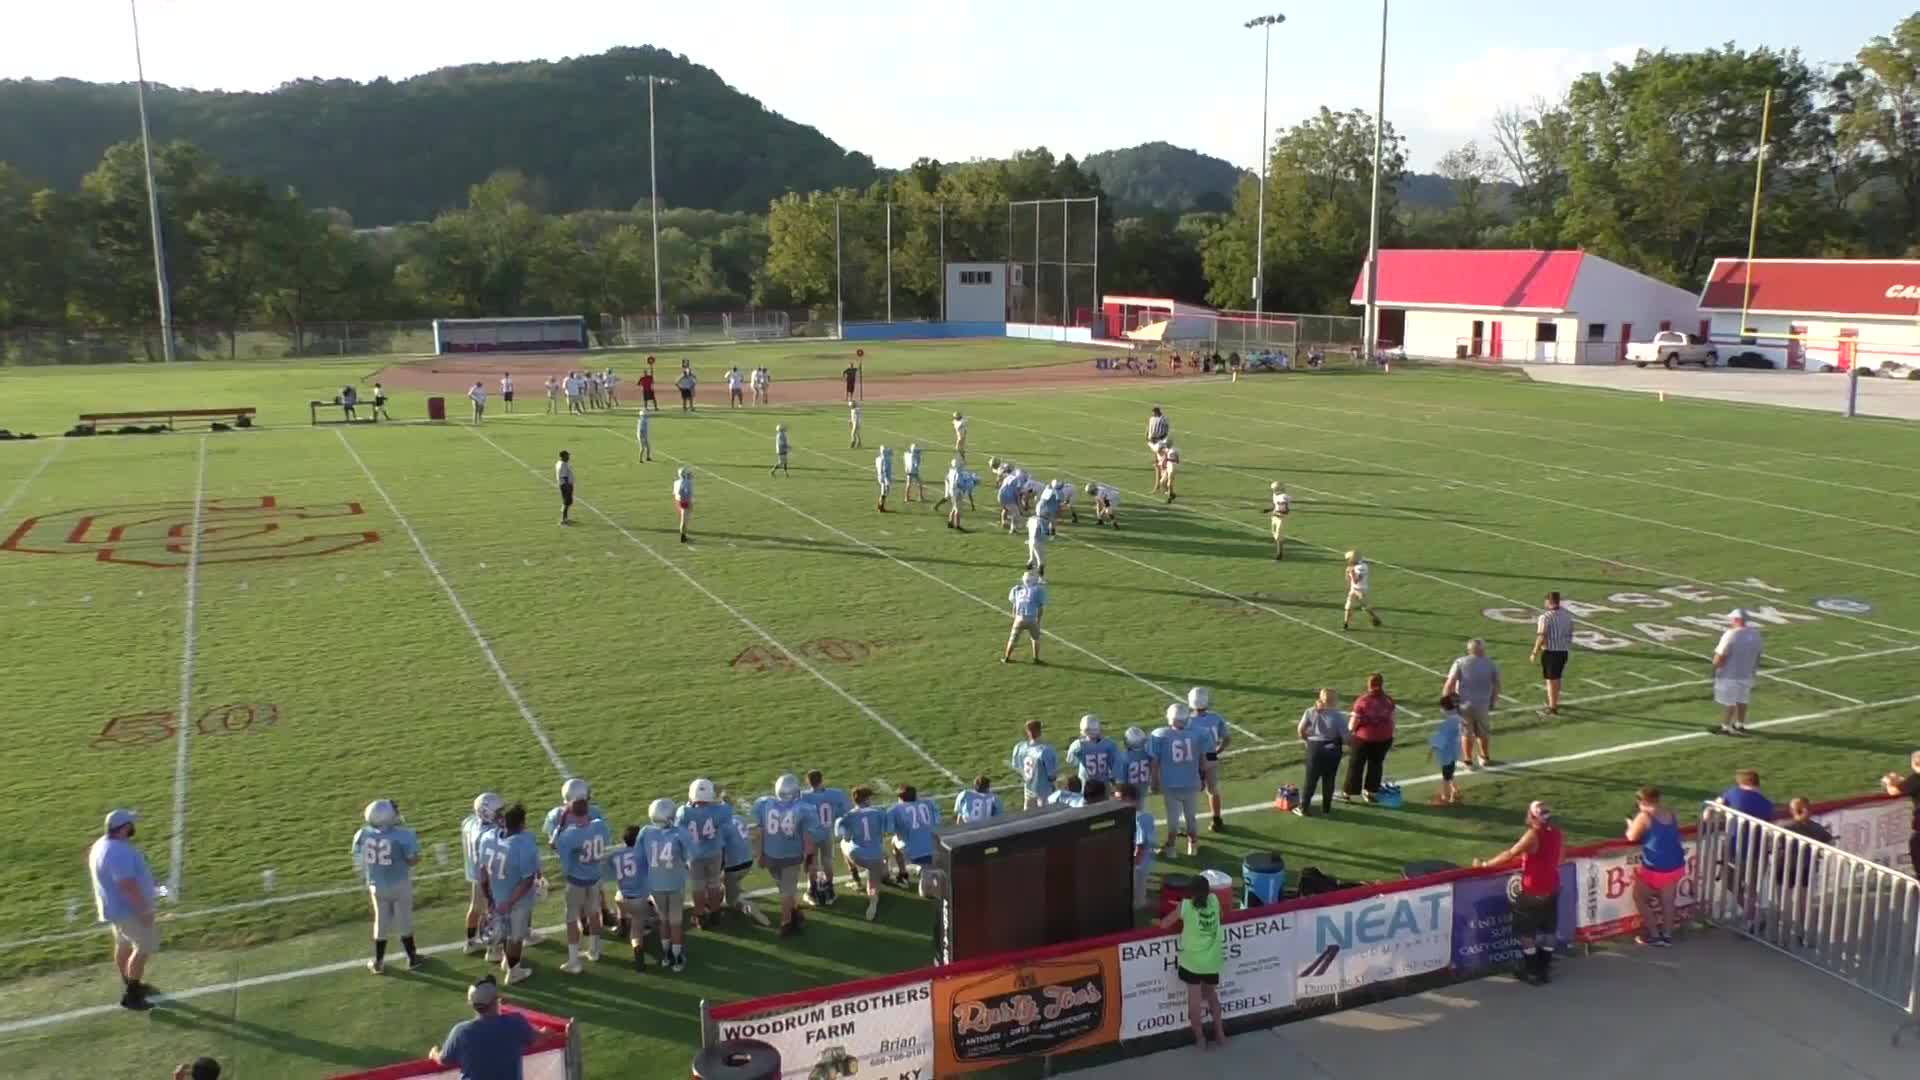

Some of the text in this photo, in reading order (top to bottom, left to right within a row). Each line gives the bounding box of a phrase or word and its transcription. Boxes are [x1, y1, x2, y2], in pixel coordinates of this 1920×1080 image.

[1085, 753, 1108, 776] 55
[1172, 738, 1193, 763] 61
[1128, 760, 1150, 784] 25
[767, 808, 795, 836] 64
[364, 838, 392, 866] 62
[579, 835, 606, 864] 30
[650, 841, 674, 870] 14
[485, 848, 508, 880] 77
[612, 851, 638, 880] 15
[1222, 917, 1292, 944] UNERAL
[1316, 892, 1451, 953] NEAT
[724, 986, 930, 1041] WOODRUM BROTHERS
[1137, 1012, 1175, 1032] GOOD
[805, 1021, 855, 1045] FARM
[879, 1034, 917, 1053] Brian
